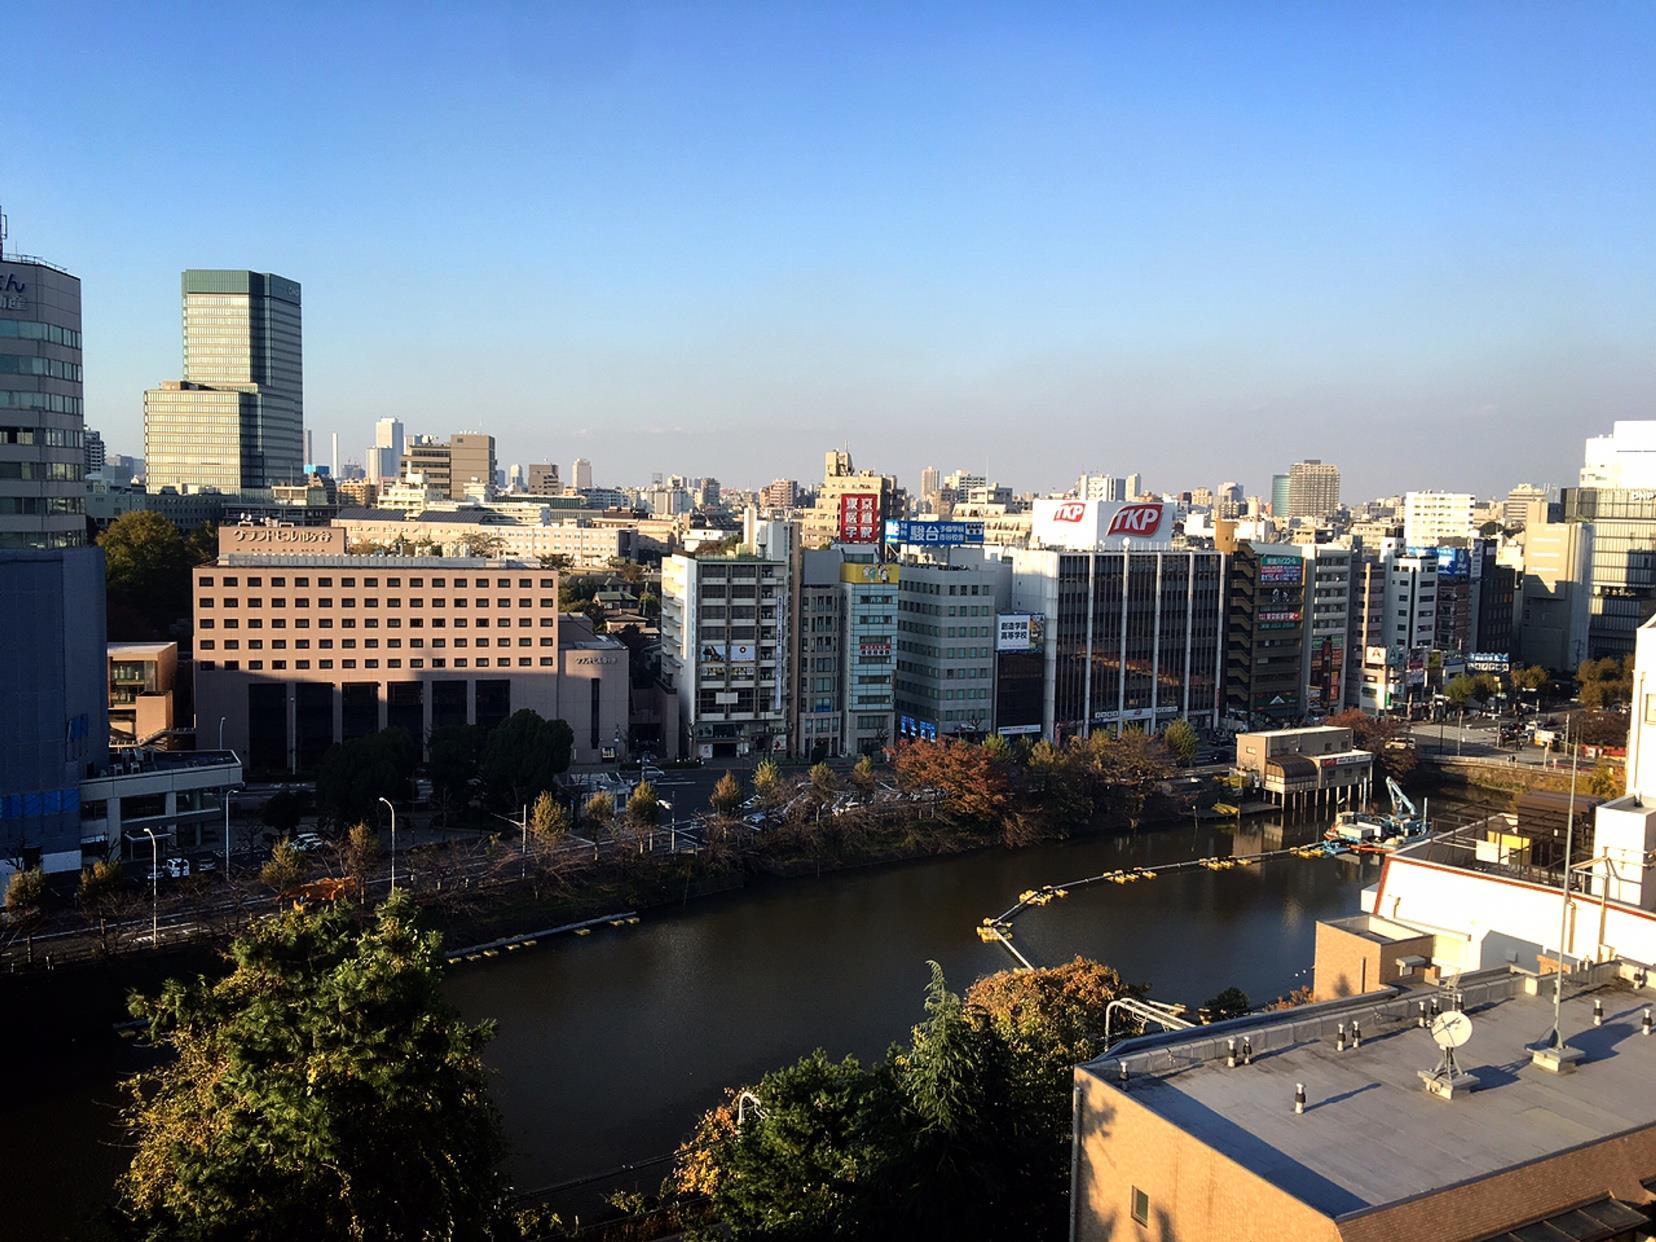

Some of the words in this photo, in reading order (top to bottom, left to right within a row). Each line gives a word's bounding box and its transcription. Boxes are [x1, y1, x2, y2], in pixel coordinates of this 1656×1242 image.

[0, 273, 25, 293] ん
[847, 497, 873, 510] 東京
[1055, 504, 1083, 520] TKP
[1114, 508, 1159, 531] TKP
[234, 529, 332, 542] グランドヒル市ヶ谷
[910, 525, 939, 541] 駿台
[1001, 631, 1028, 640] 高等学校
